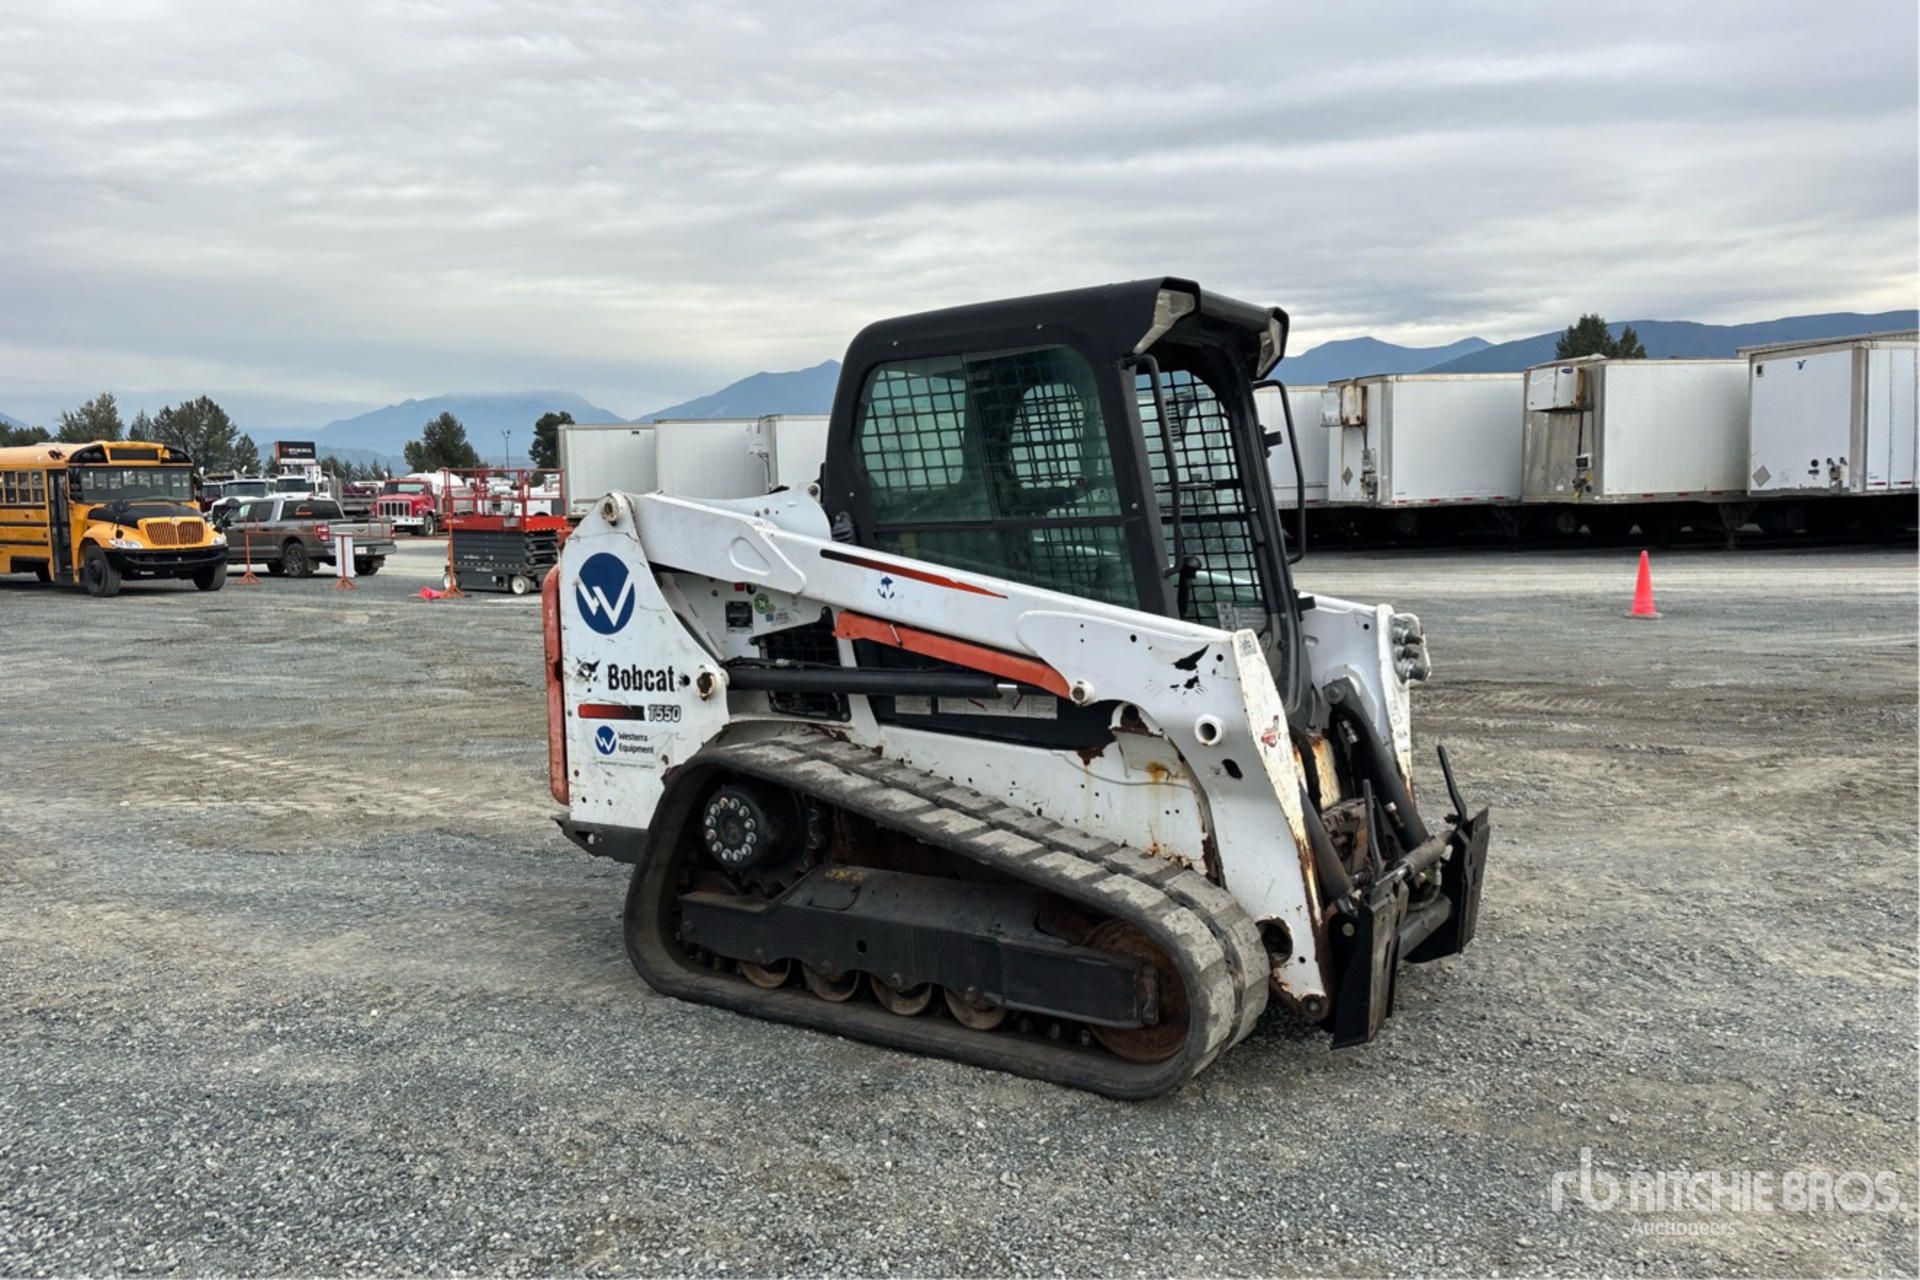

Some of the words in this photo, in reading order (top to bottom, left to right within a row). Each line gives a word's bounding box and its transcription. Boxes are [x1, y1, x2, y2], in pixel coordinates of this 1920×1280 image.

[607, 663, 675, 692] Bobcat
[648, 704, 681, 722] T550
[619, 743, 654, 754] Equipment
